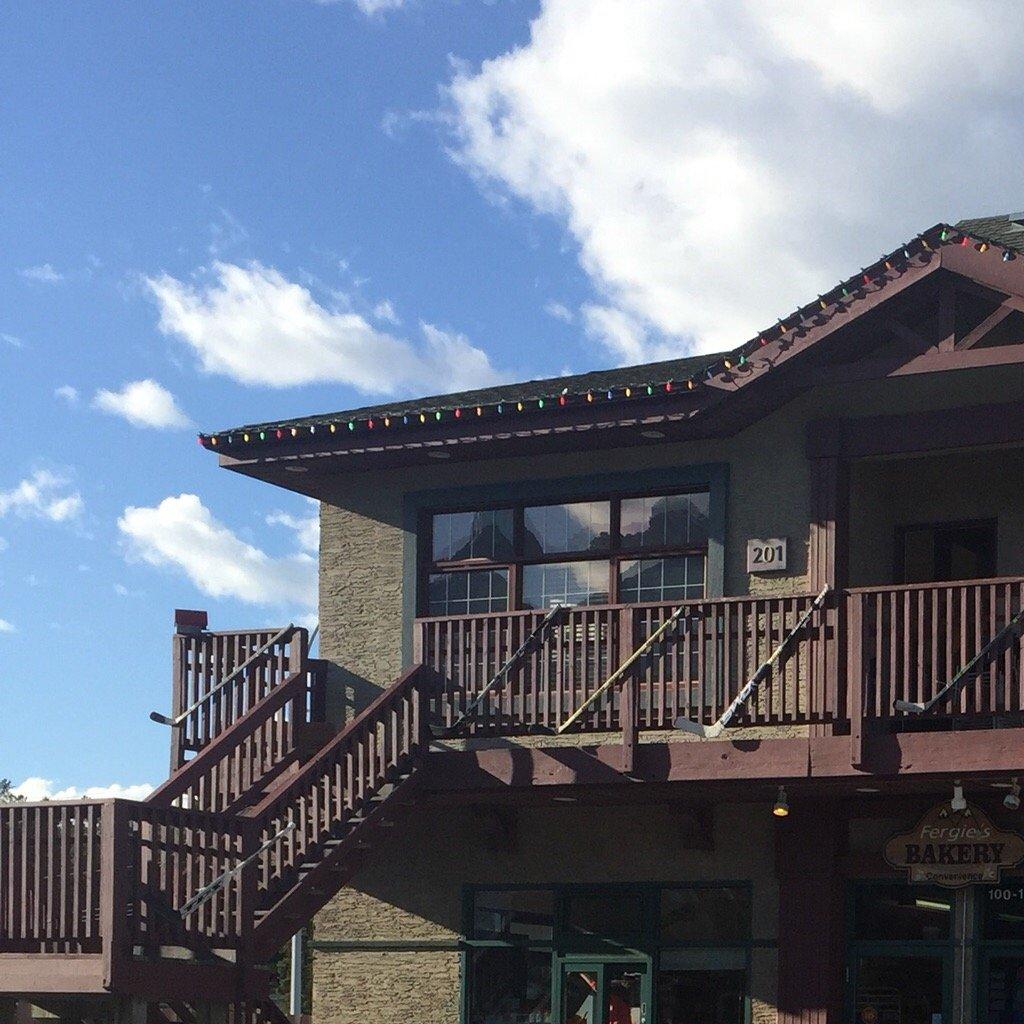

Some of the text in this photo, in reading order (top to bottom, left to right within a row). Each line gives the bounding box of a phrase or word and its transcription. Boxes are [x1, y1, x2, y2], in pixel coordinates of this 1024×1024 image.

[753, 544, 783, 564] 201
[920, 823, 992, 842] Fergie's
[905, 843, 1006, 865] BAKERY
